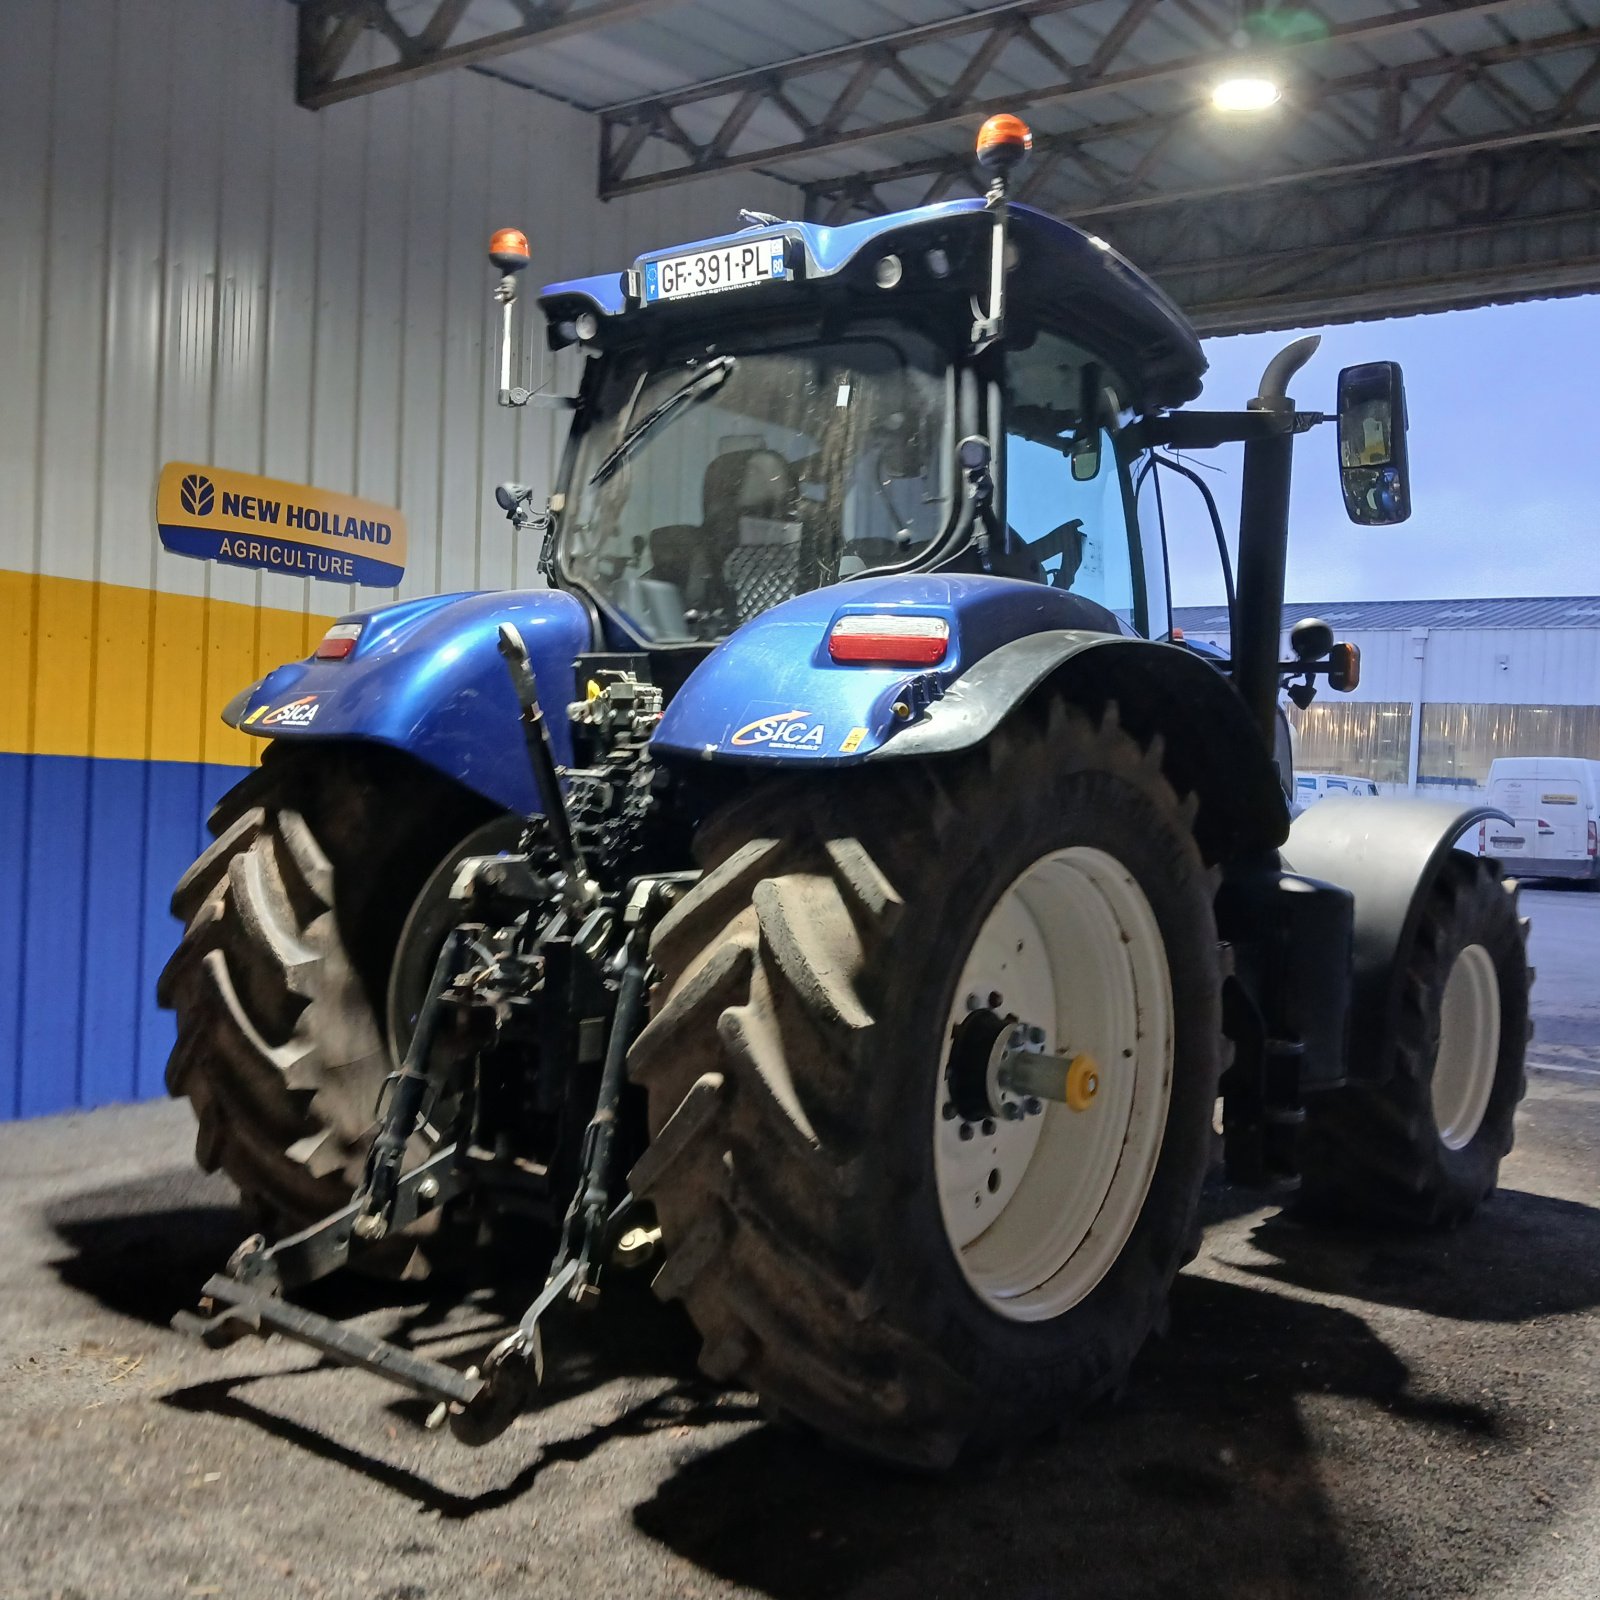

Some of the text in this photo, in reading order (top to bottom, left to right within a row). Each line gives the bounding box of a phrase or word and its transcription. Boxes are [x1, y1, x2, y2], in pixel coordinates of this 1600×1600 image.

[662, 246, 768, 293] GF-391-PL
[772, 258, 784, 274] 80
[669, 280, 761, 300] www.sica-agriculture.fr
[222, 491, 391, 545] NEW HOLLAND
[219, 537, 353, 576] AGRICULTURE
[276, 704, 319, 720] SICA
[754, 720, 825, 744] SICA
